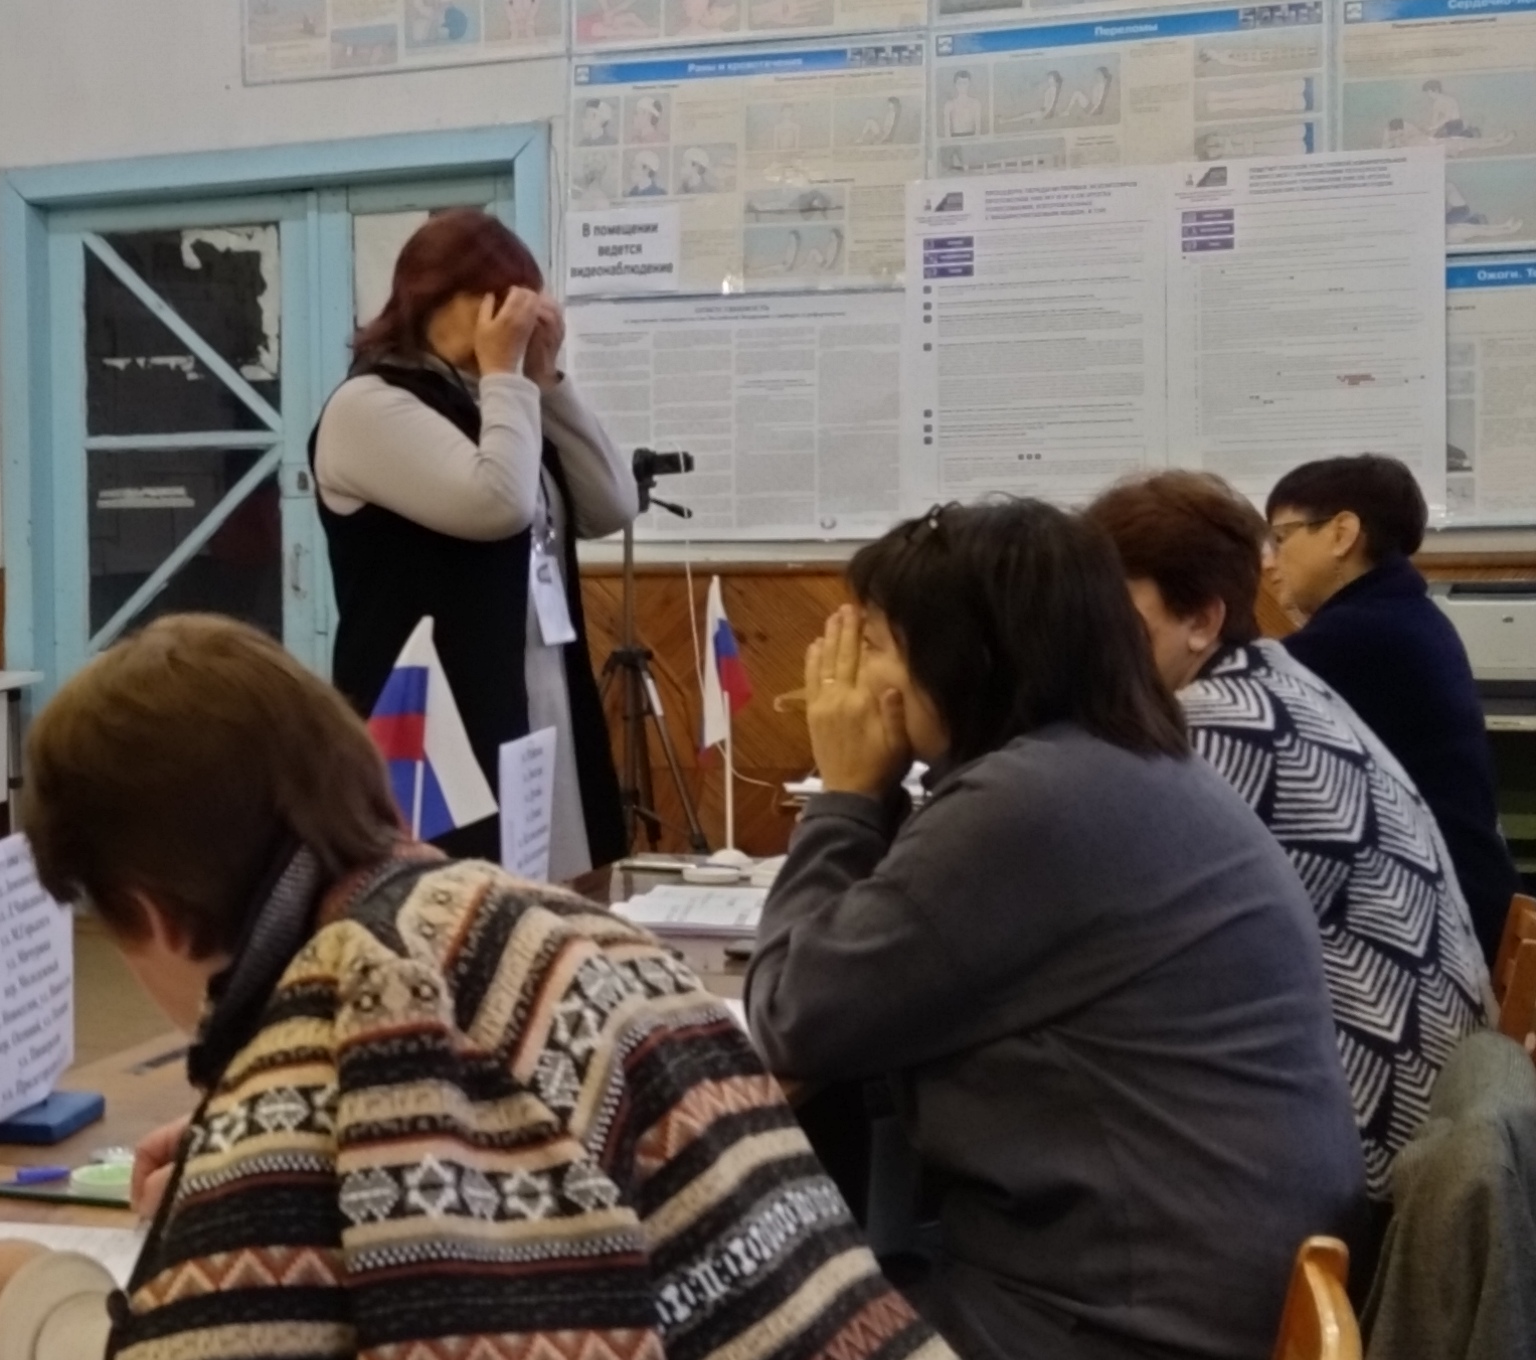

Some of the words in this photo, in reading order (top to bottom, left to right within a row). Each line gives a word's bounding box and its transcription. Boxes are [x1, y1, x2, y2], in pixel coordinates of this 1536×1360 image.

[1094, 23, 1158, 37] Переломы
[582, 222, 591, 238] В
[593, 223, 658, 236] помещении
[597, 243, 642, 257] ведется
[570, 260, 674, 278] видеонаблюдение
